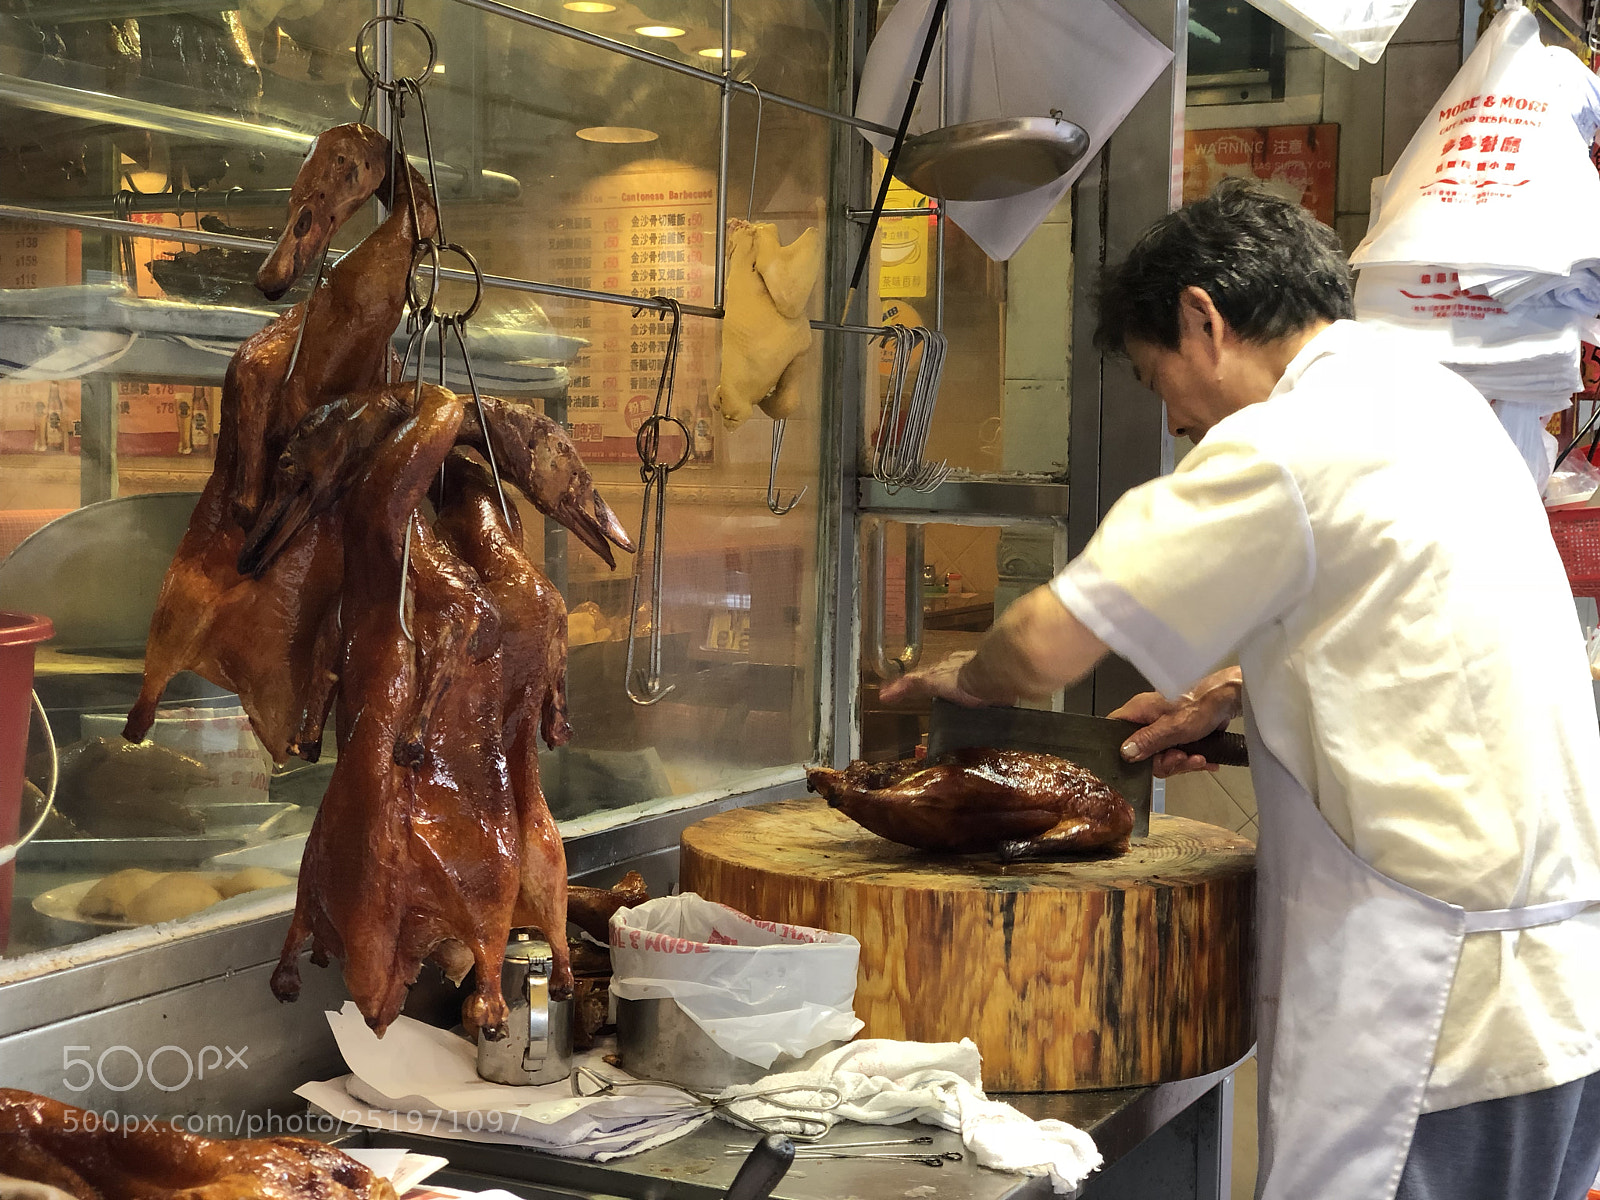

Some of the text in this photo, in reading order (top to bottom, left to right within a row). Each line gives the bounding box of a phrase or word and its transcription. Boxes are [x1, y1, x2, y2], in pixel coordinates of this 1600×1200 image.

[1439, 96, 1481, 122] MORE
[1483, 95, 1496, 108] &
[1194, 141, 1265, 155] WARNING
[1273, 139, 1303, 155] 注意
[621, 189, 713, 202] Cantonese Barbecued
[156, 402, 175, 415] $78
